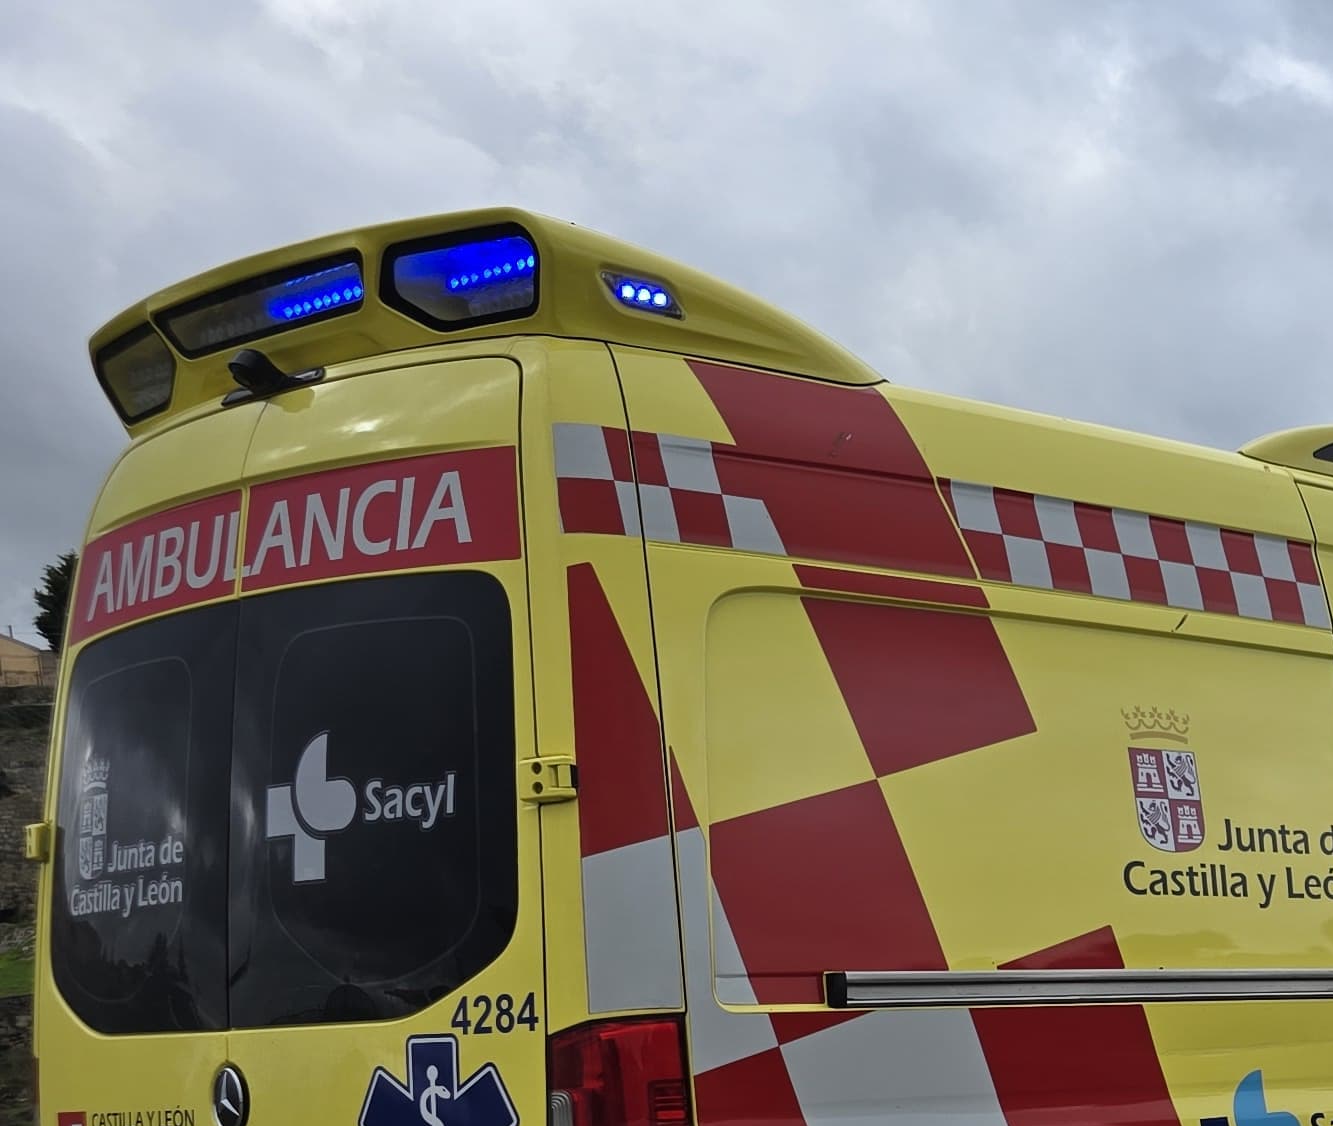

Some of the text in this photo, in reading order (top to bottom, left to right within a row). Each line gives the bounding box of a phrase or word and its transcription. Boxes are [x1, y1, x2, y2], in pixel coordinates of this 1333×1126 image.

[87, 470, 473, 622] AMBULANCIA
[364, 773, 455, 829] Sacyl
[107, 835, 184, 873] Junta de
[1217, 818, 1310, 855] Junta
[71, 874, 183, 918] Castilla y León
[1123, 860, 1249, 898] Castilla
[1256, 871, 1276, 909] y
[451, 991, 539, 1036] 4284
